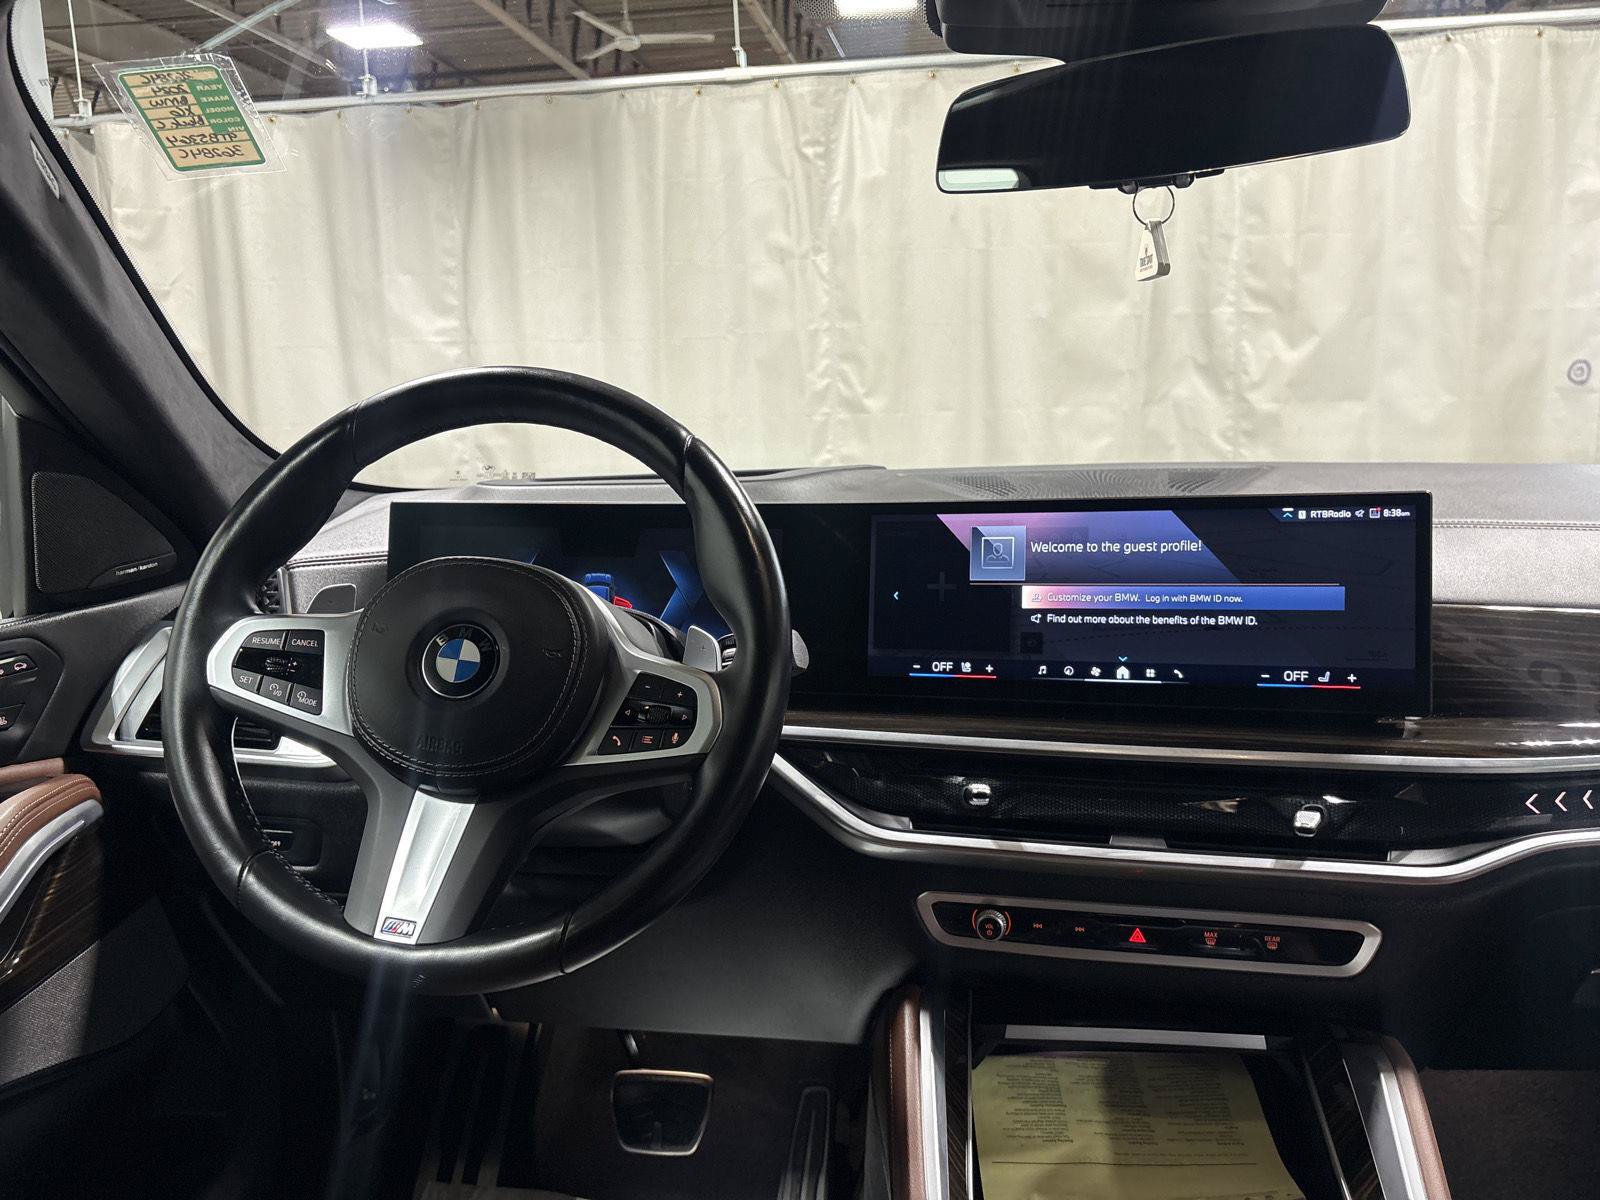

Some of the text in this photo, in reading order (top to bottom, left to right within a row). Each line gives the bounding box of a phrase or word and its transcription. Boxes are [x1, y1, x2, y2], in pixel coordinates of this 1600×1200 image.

[1030, 540, 1203, 555] Welcome to the guest profile!
[1047, 592, 1092, 602] Customize
[1093, 593, 1112, 603] your
[1114, 593, 1141, 602] BMW.
[1145, 594, 1160, 603] Log
[1162, 594, 1169, 602] in
[1170, 594, 1187, 603] with
[1189, 594, 1212, 603] BMW
[1213, 594, 1222, 603] ID
[1047, 614, 1258, 626] Find out more about the benefits of the BMW ID.
[252, 637, 280, 645] RESUME
[291, 639, 318, 647] CANCEL
[932, 661, 954, 672] OFF
[240, 675, 252, 684] SET
[1283, 670, 1309, 682] OFF
[299, 697, 318, 707] MODE
